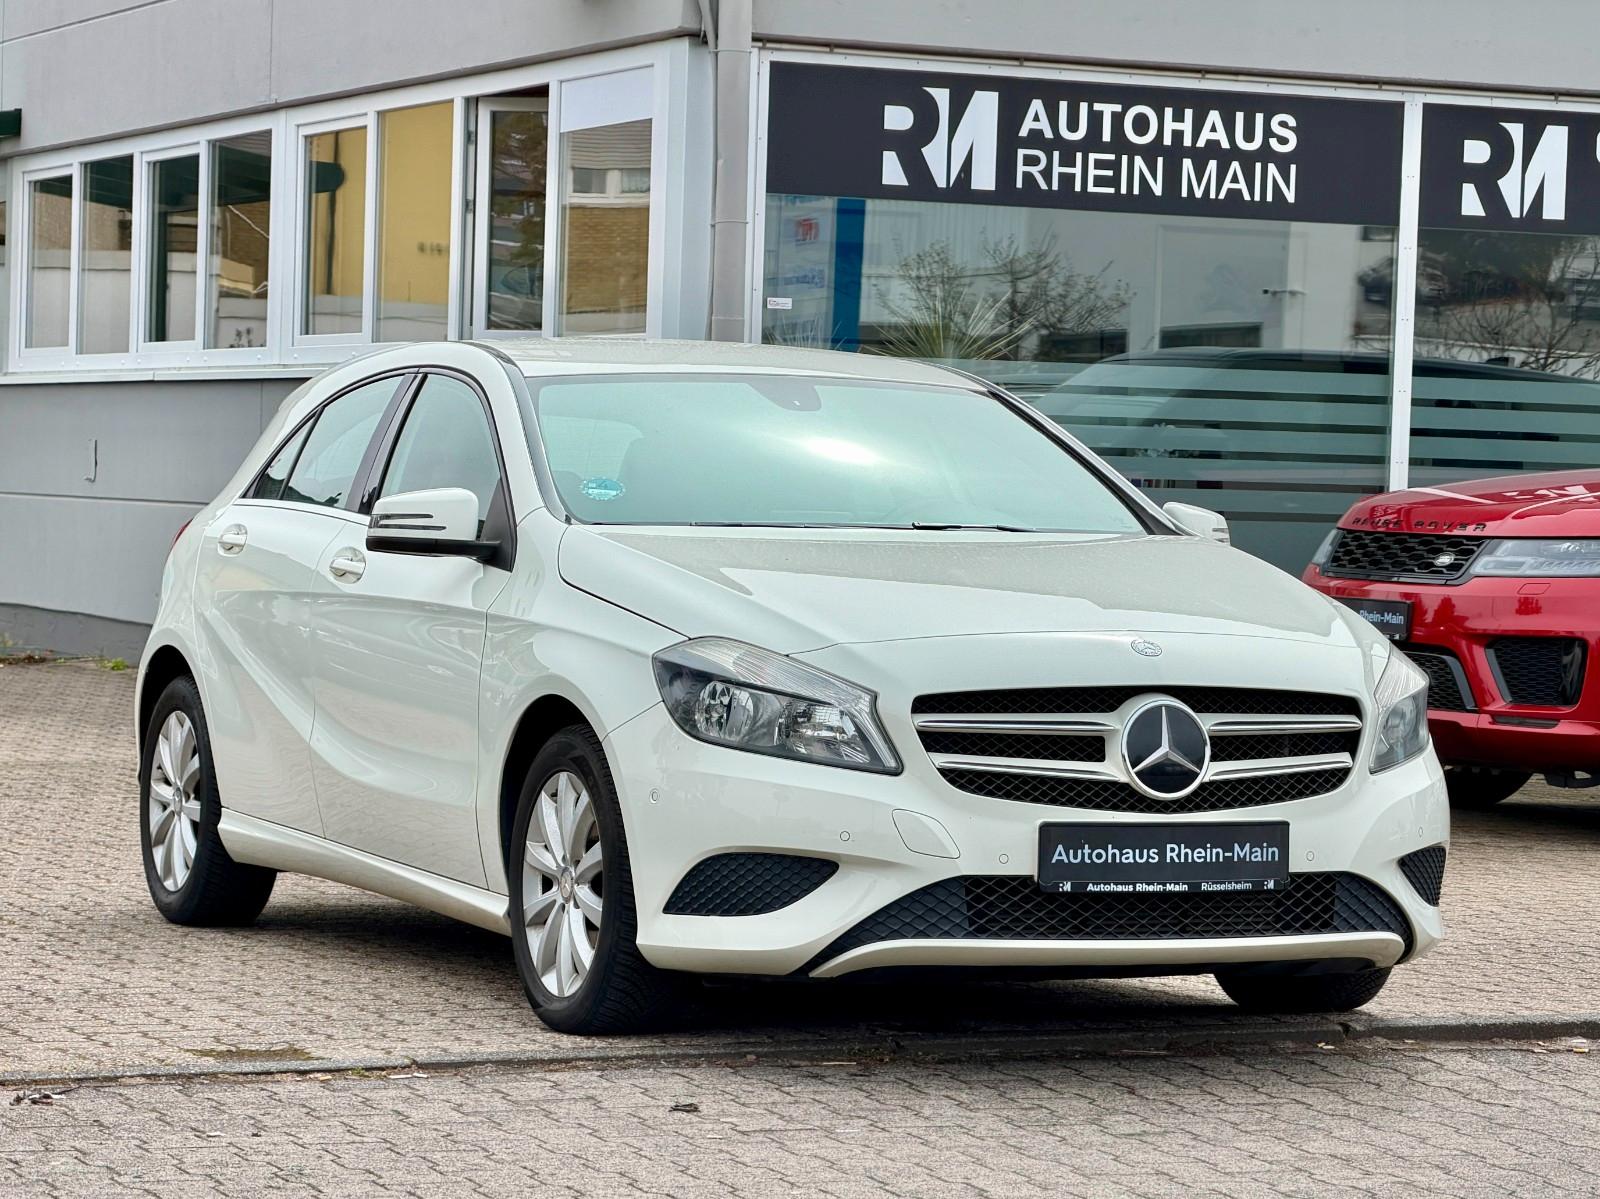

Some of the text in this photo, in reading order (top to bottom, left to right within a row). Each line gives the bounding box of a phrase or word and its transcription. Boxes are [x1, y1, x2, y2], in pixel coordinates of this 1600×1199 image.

[881, 87, 999, 191] RM
[1018, 98, 1298, 152] AUTOHAUS
[1015, 148, 1298, 204] RHEIN MAIN
[1461, 122, 1569, 221] RM
[1051, 842, 1280, 864] Autohaus Rhein-Main
[1086, 882, 1134, 892] Autohaus
[1135, 882, 1189, 892] Rhein-Main
[1201, 881, 1252, 891] Rüsselsheim
